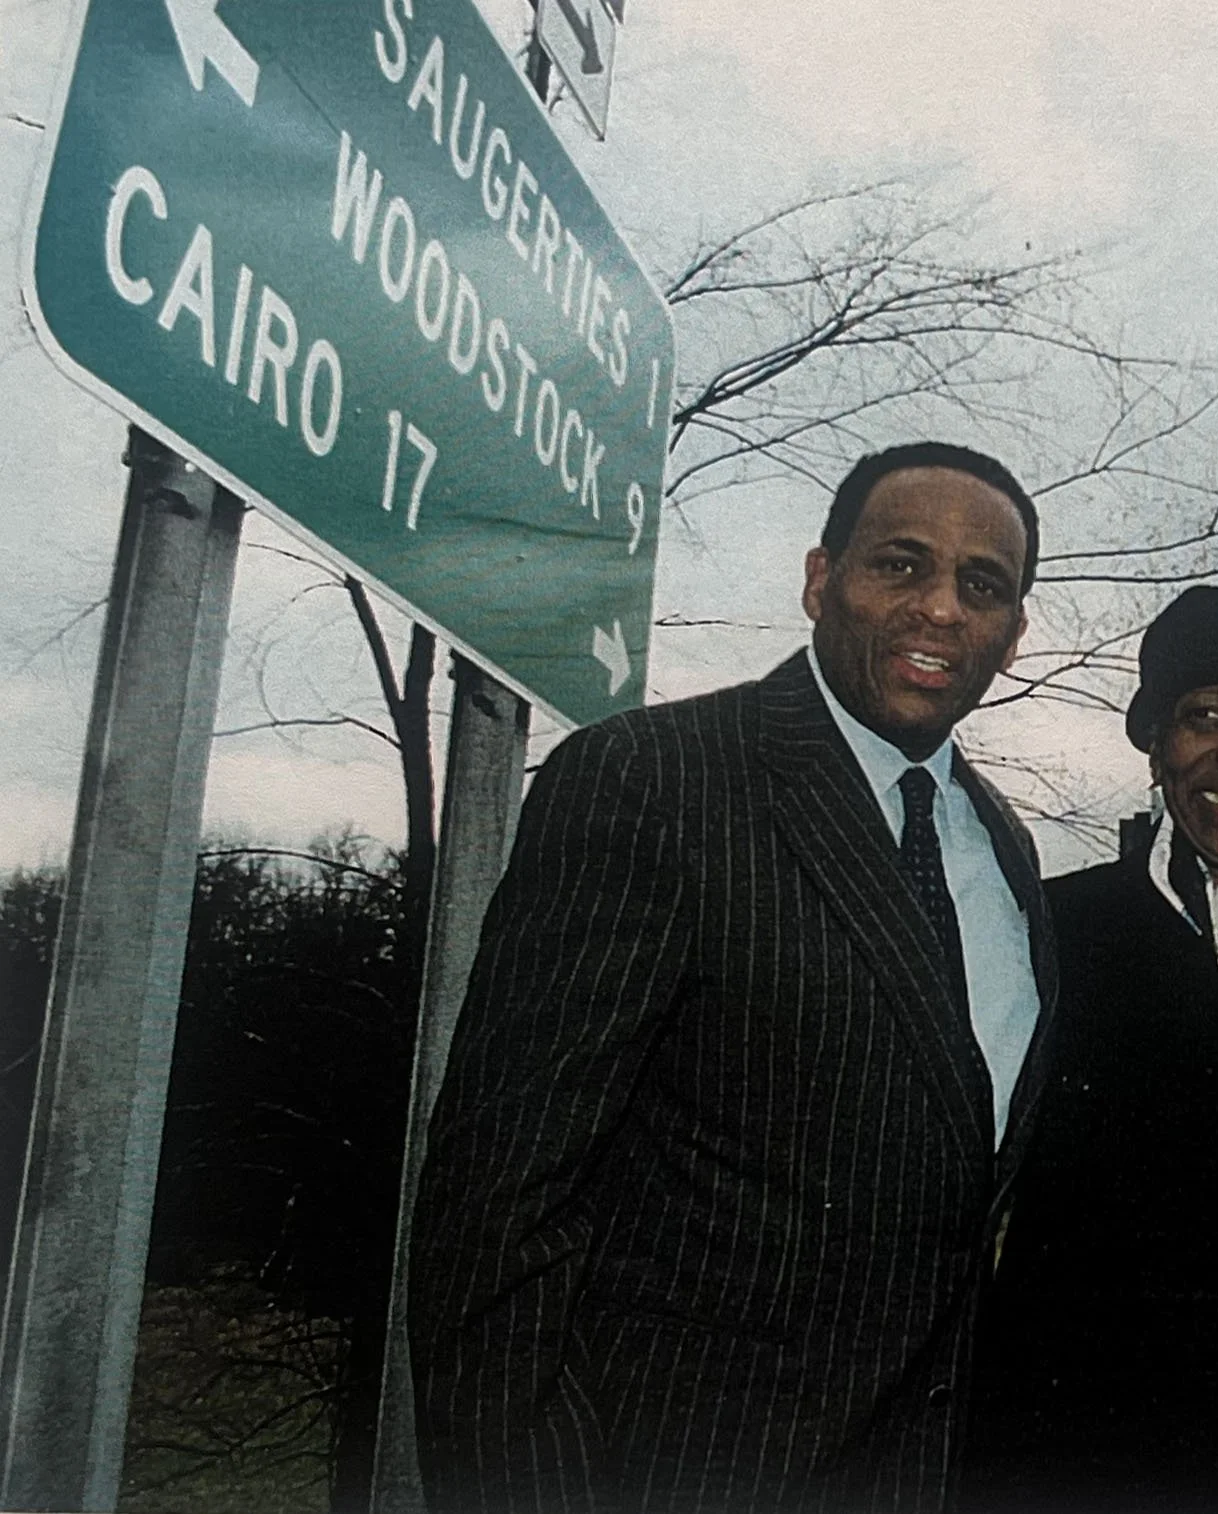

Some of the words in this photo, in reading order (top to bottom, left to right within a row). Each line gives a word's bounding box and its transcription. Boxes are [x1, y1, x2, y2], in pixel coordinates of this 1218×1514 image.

[105, 165, 343, 457] CAIRO
[381, 410, 438, 530] 17
[331, 130, 605, 519] WOODSTOCK
[627, 483, 644, 554] 9
[374, 0, 629, 387] SAUGERTIES
